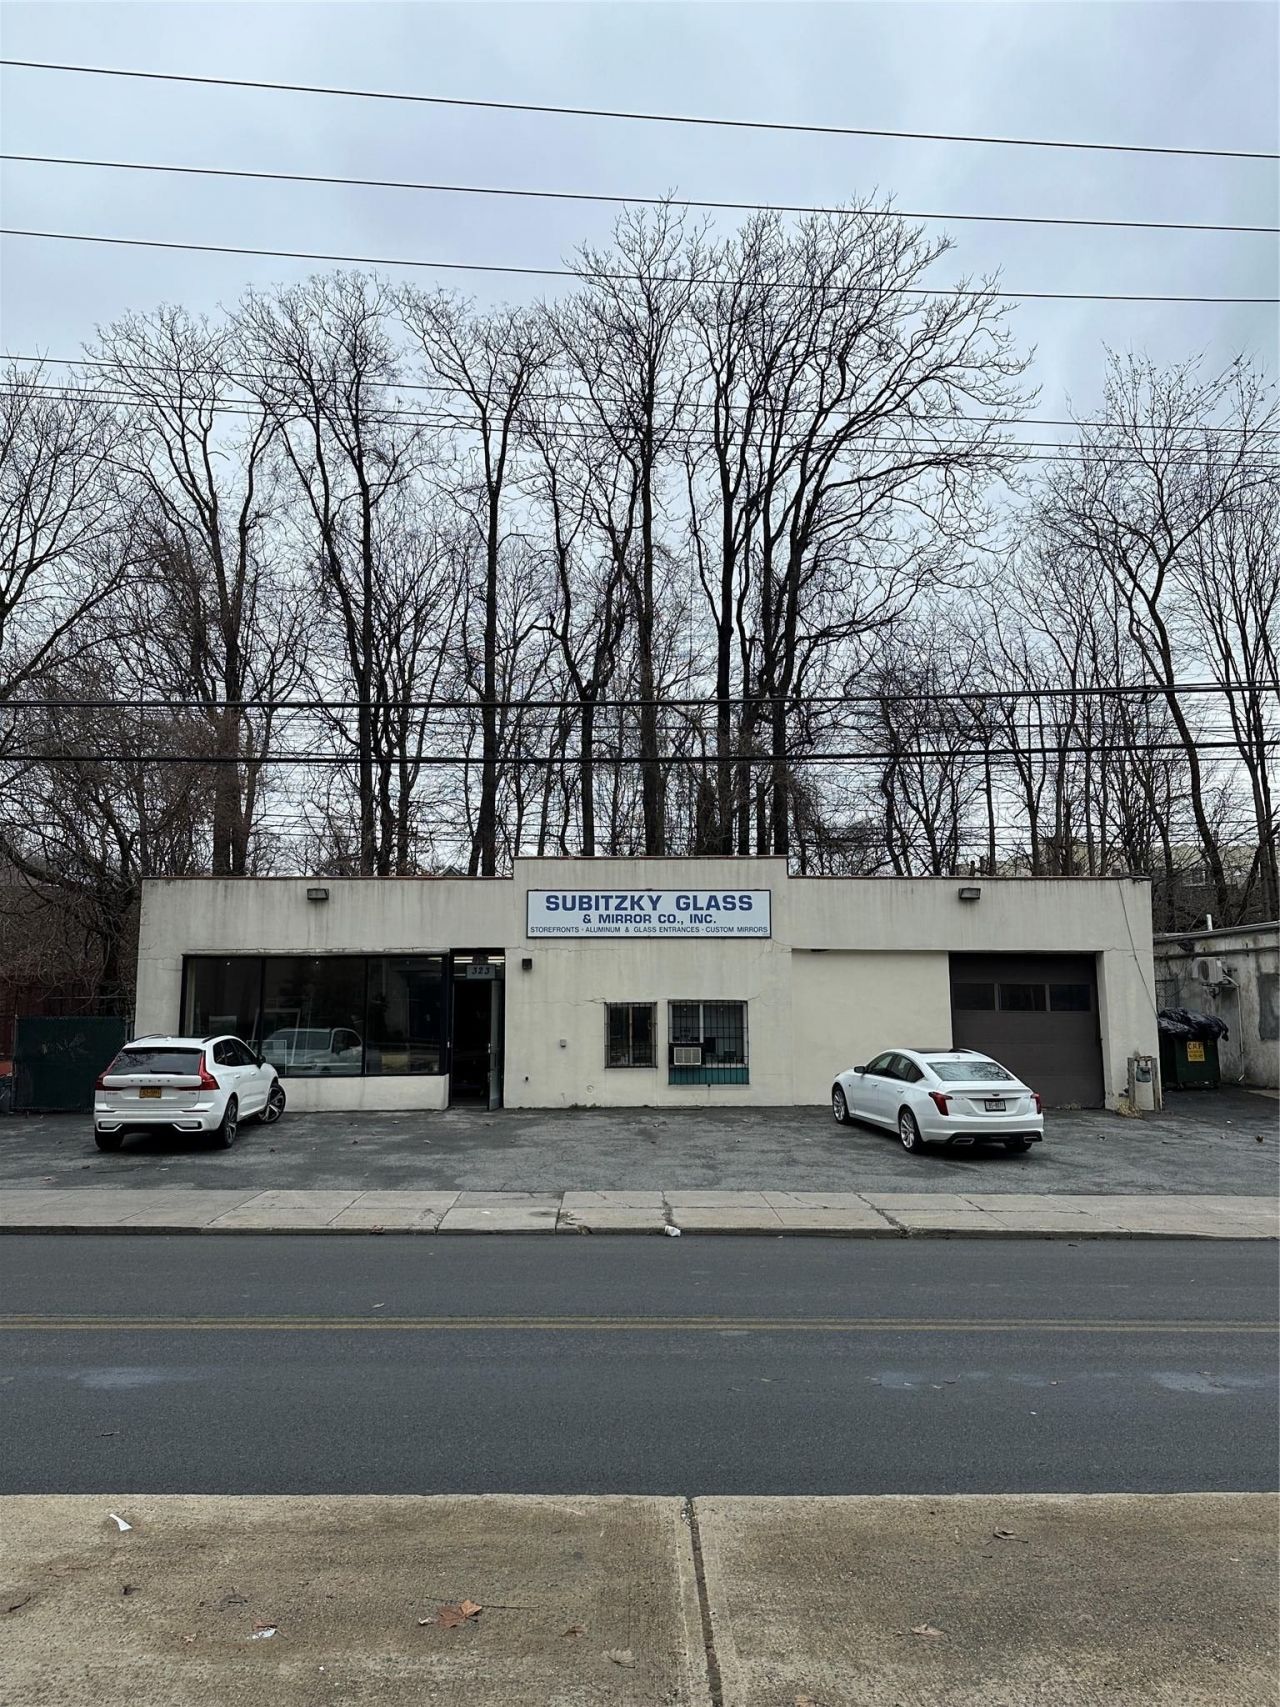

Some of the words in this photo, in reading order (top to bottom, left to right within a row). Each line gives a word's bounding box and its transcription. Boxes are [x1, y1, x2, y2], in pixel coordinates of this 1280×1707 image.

[545, 894, 663, 912] SUBITZKY
[675, 894, 753, 912] GLASS
[582, 913, 592, 924] &
[598, 913, 652, 924] MIRROR
[657, 913, 684, 926] CO.,
[689, 913, 717, 924] INC.
[471, 966, 490, 975] 323
